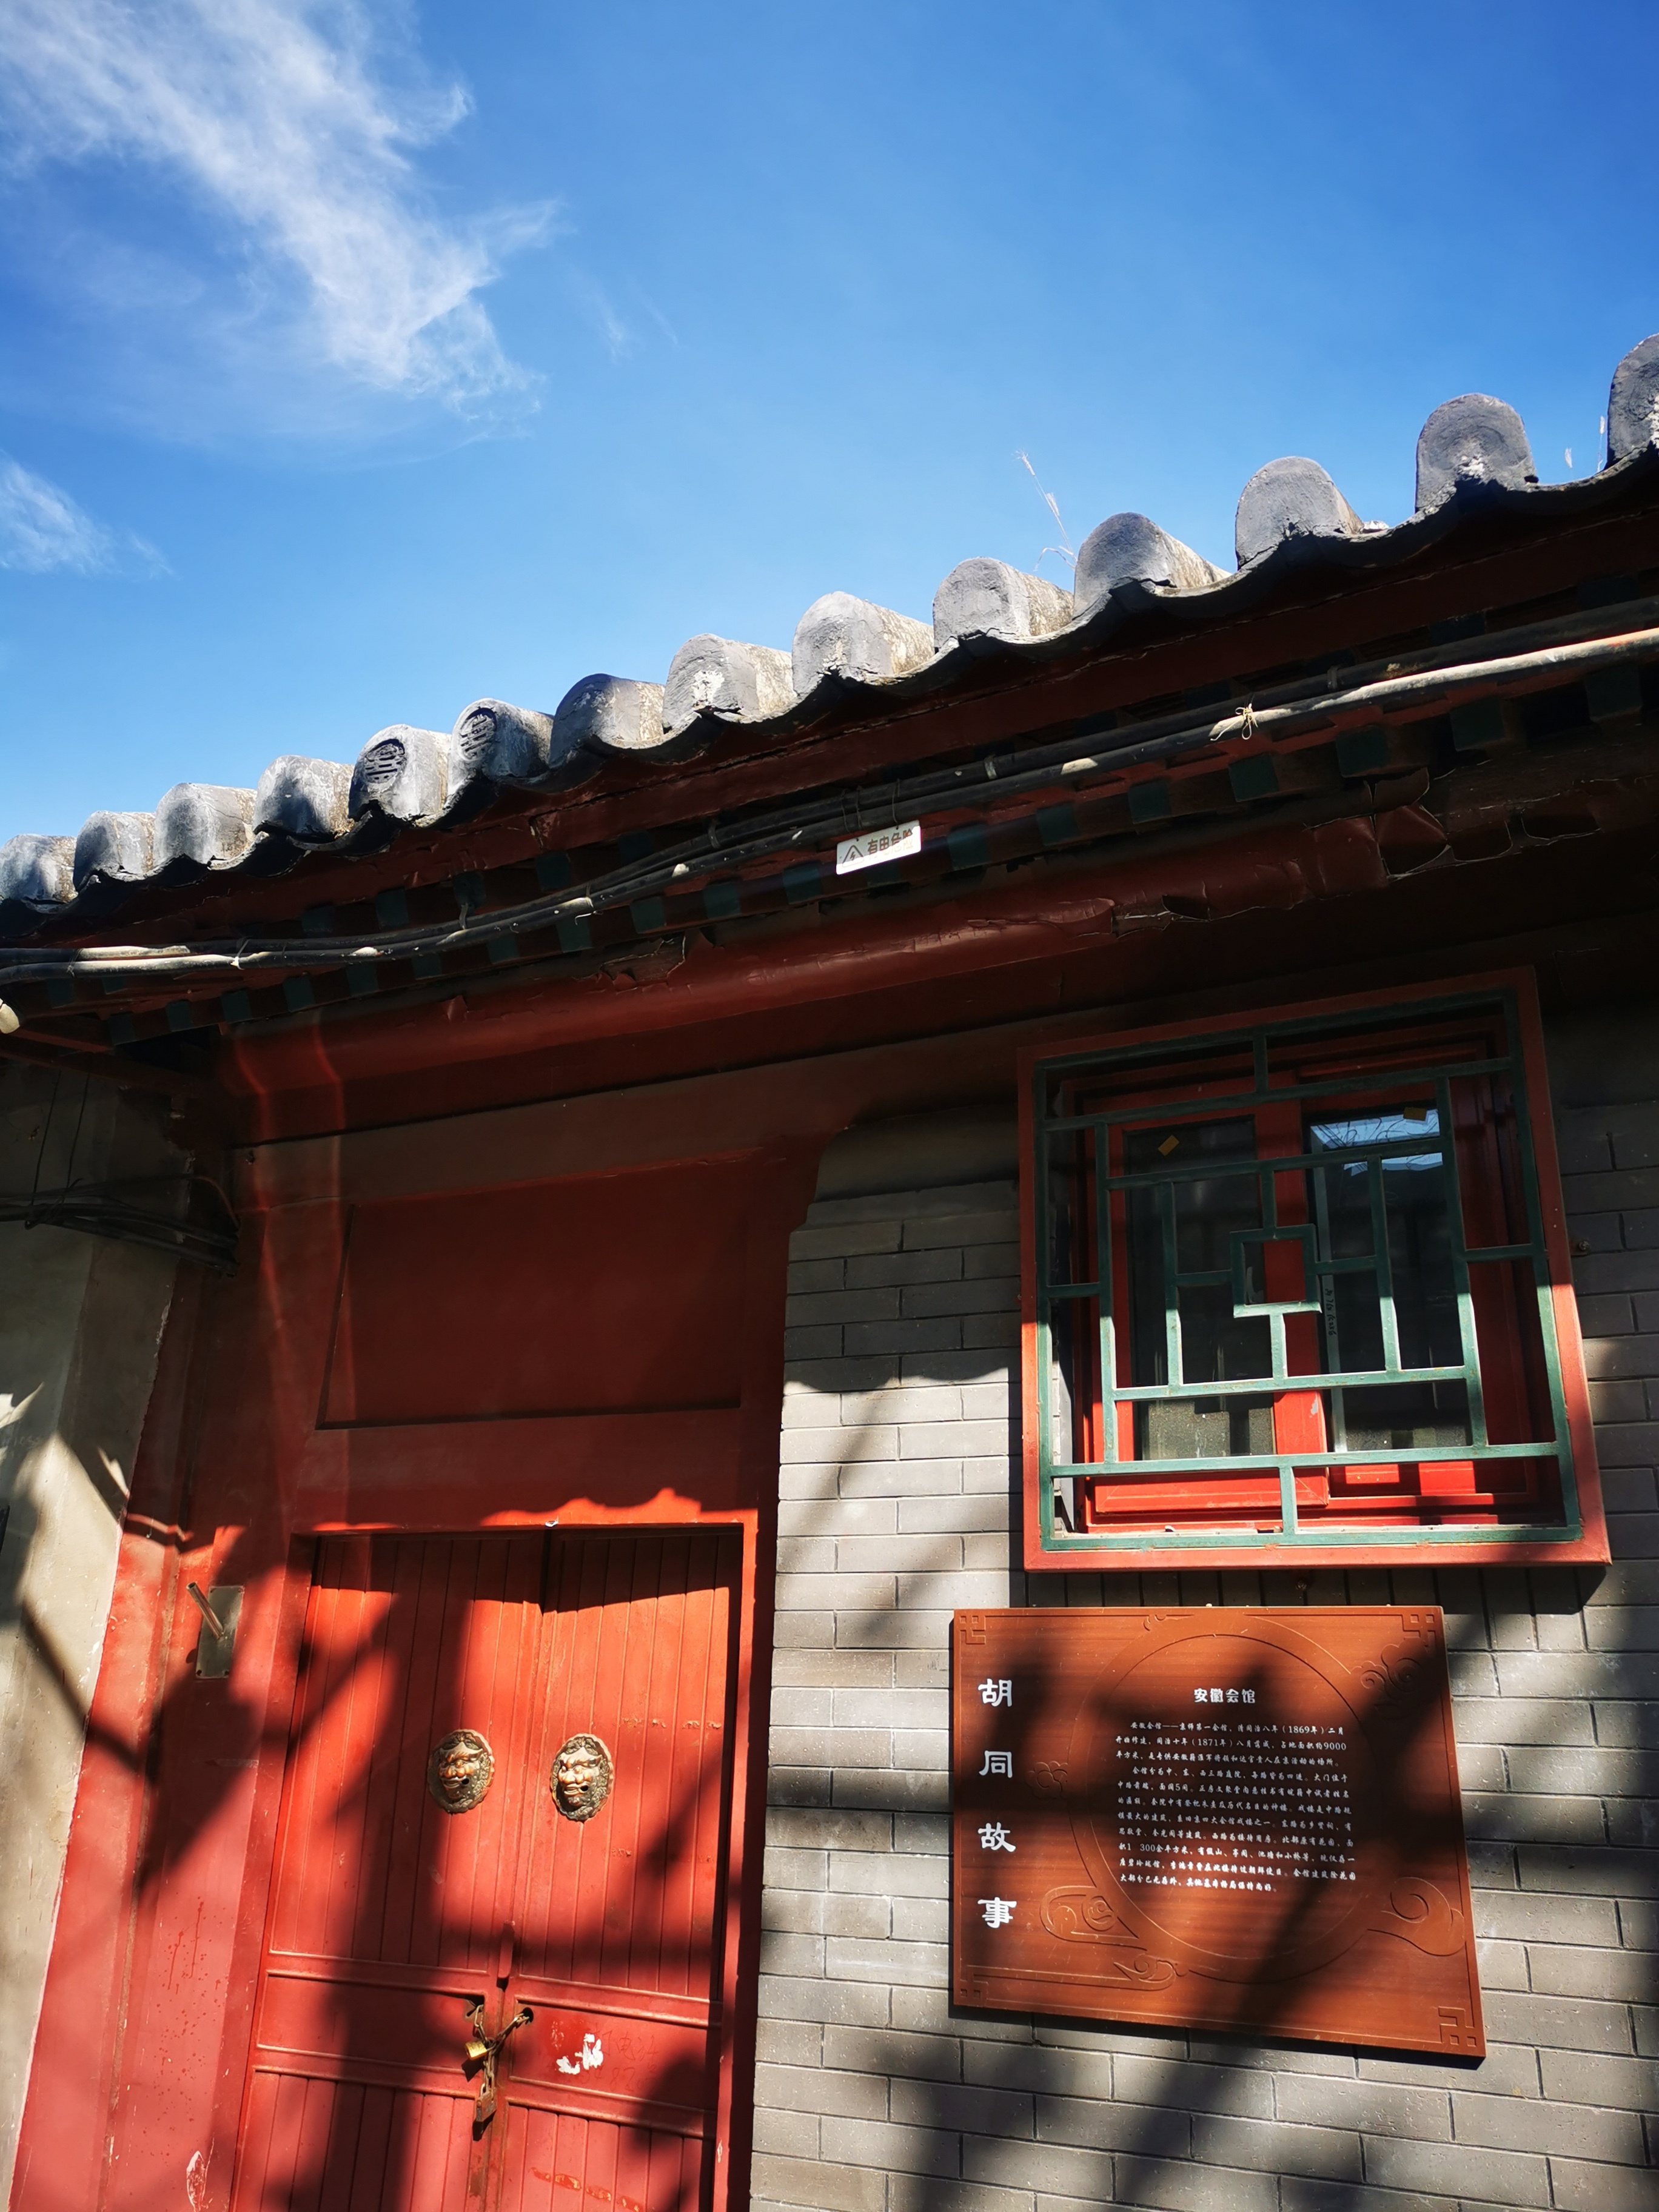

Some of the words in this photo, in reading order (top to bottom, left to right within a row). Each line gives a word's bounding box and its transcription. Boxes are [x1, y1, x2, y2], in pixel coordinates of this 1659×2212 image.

[1194, 1688, 1255, 1703] 安徽会馆
[977, 1678, 1017, 1928] 胡同故事
